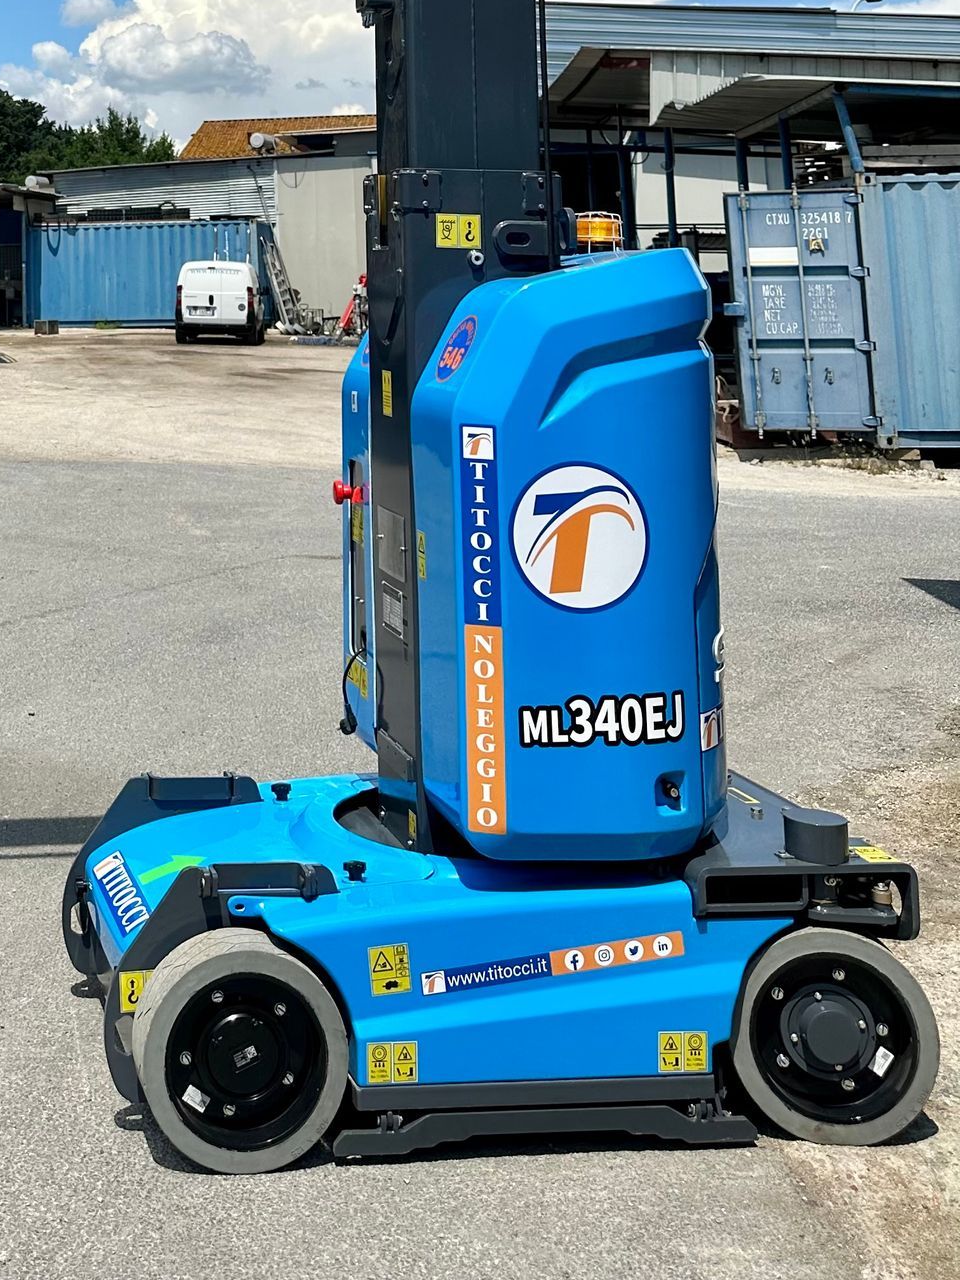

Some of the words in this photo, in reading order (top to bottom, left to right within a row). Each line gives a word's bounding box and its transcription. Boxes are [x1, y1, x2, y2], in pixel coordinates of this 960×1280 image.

[766, 213, 790, 225] CTXU
[801, 211, 841, 225] 325418
[845, 211, 852, 224] 7
[802, 227, 829, 239] 22G1
[763, 297, 787, 309] TARE
[764, 310, 781, 322] NET
[440, 346, 465, 370] 546
[469, 461, 493, 622] TITOCCI
[473, 634, 498, 828] NOLEGGIO
[521, 694, 684, 745] ML340EJ
[102, 863, 150, 933] TITOCCI
[447, 957, 548, 987] www.titocci.it
